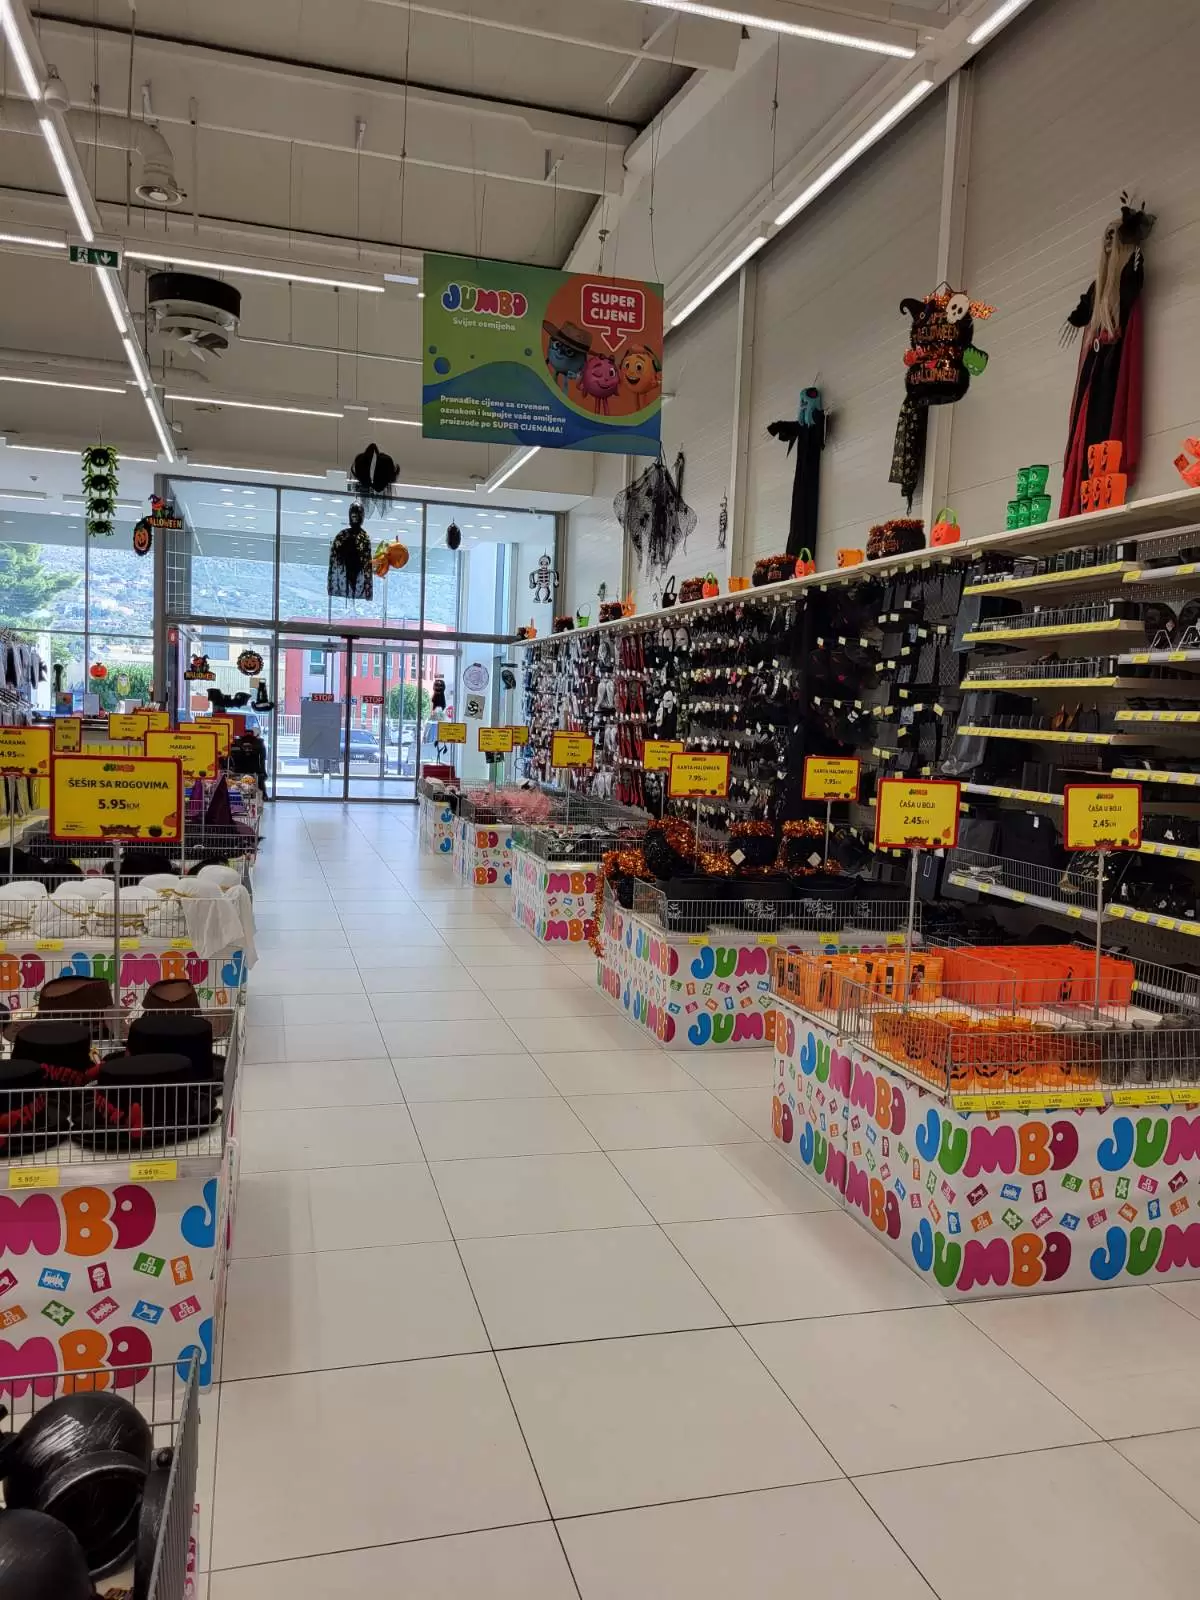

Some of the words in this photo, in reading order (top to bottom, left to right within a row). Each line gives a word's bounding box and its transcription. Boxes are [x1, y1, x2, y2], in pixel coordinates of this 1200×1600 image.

[441, 283, 528, 318] JUMBO
[592, 292, 635, 308] SUPER
[590, 307, 636, 323] CIJENE
[453, 317, 477, 327] Svijet
[478, 320, 515, 331] osmijeha
[481, 398, 505, 407] cijene
[516, 403, 550, 411] crvenom
[440, 407, 477, 416] oznakom
[533, 414, 566, 423] omiljene
[440, 417, 479, 426] proizvode
[492, 421, 519, 430] SUPER
[520, 423, 564, 433] CIJENAMA!
[313, 694, 333, 702] STOP
[68, 777, 97, 788] ŠEŠIR
[99, 780, 113, 788] SA
[114, 780, 168, 789] ROGOVIMA
[900, 800, 915, 808] ČAŠA
[1088, 804, 1103, 812] ČAŠA
[59, 951, 209, 988] JUMBO
[915, 1109, 1079, 1178] JUMBO
[911, 1217, 1071, 1291] JUMBO
